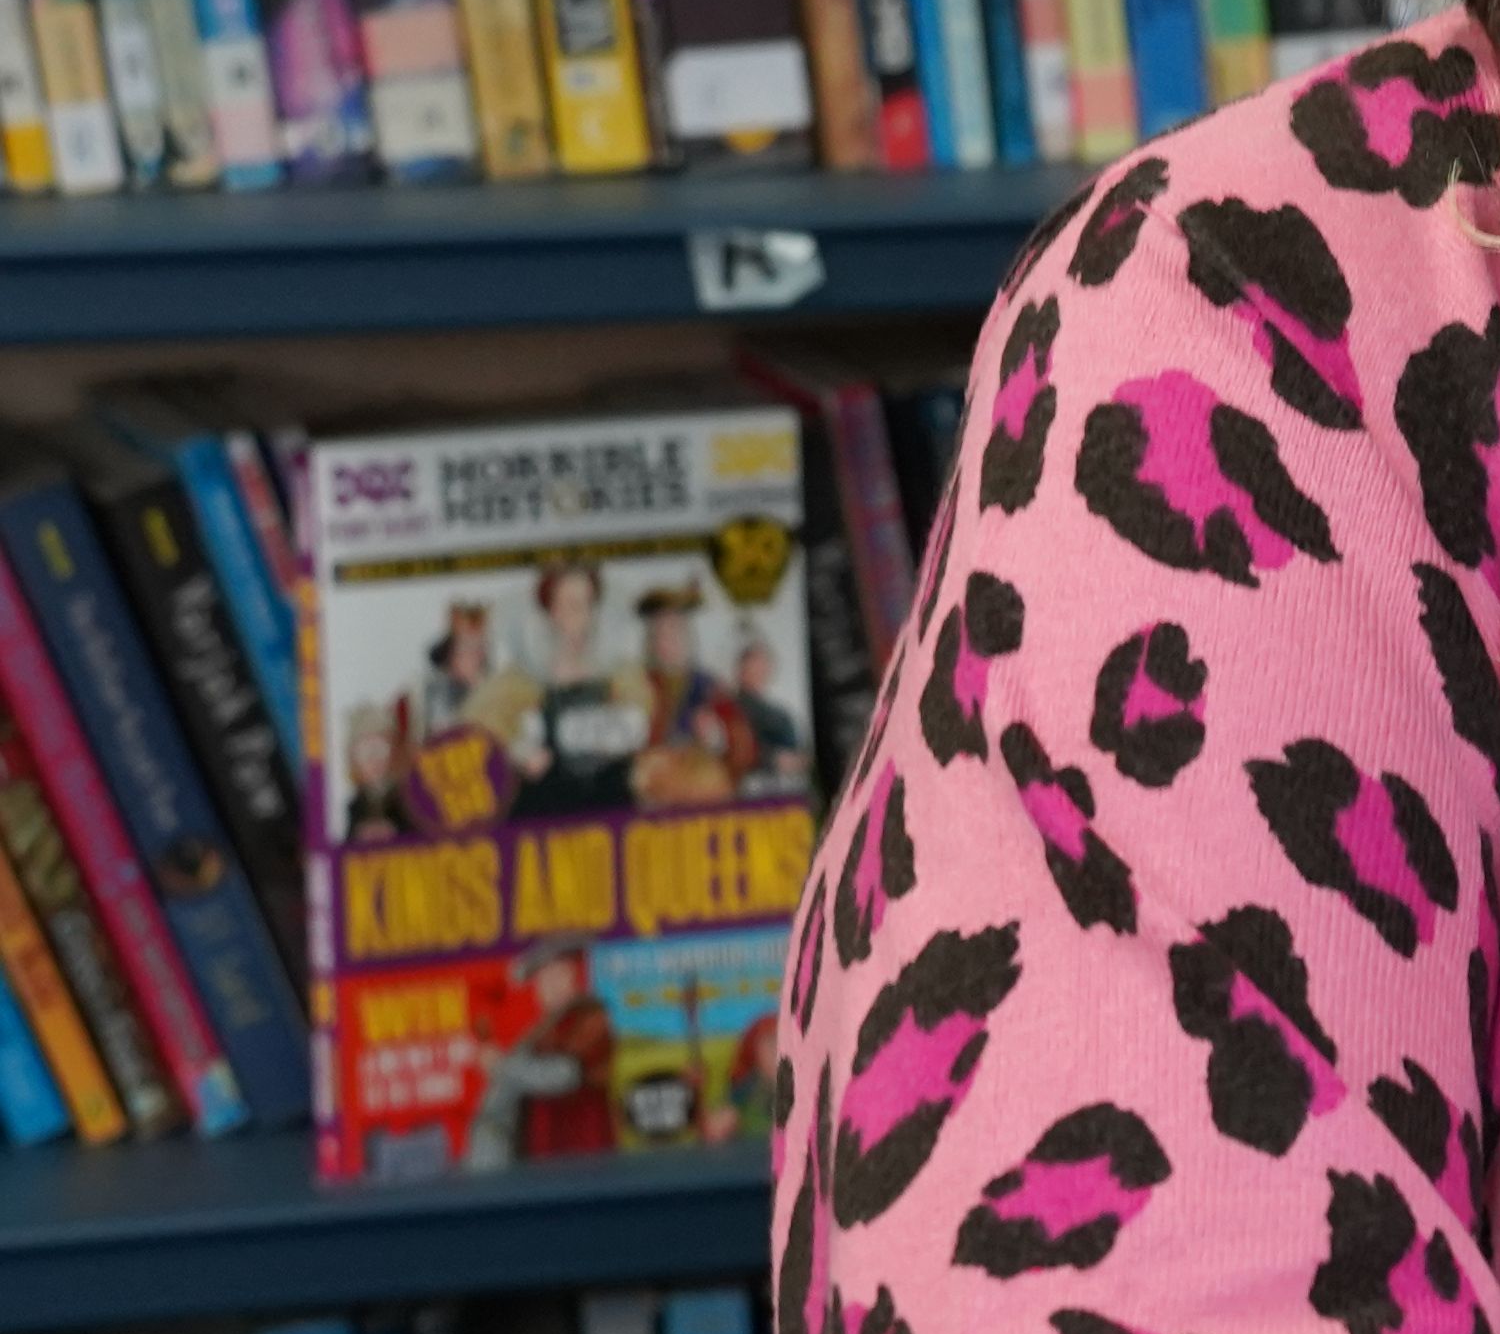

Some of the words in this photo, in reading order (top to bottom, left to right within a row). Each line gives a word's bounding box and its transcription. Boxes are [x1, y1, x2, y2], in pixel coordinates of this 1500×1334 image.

[345, 839, 499, 959] KINGS
[514, 825, 616, 937] AND
[625, 806, 815, 937] QUEENS
